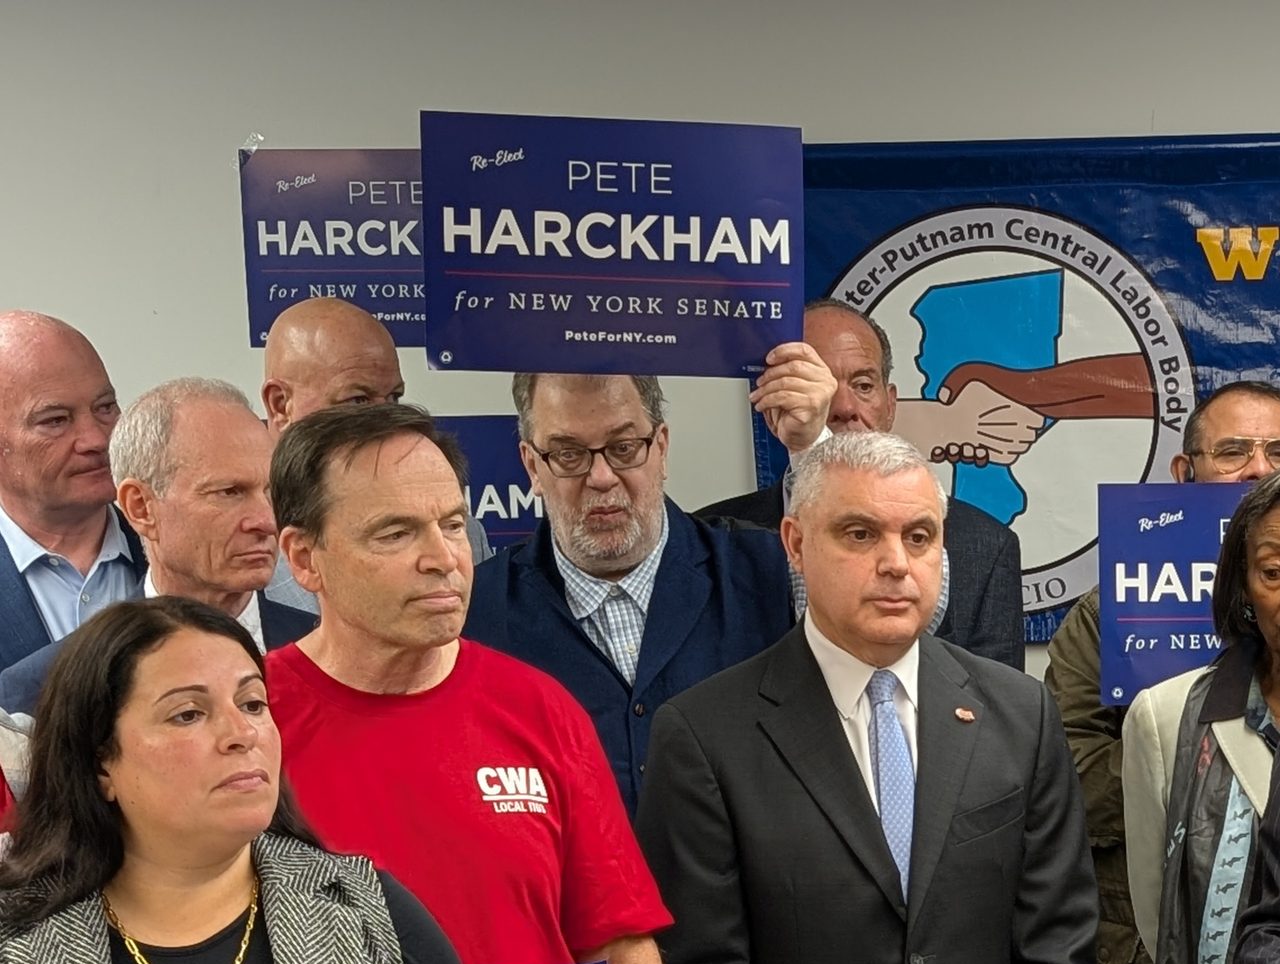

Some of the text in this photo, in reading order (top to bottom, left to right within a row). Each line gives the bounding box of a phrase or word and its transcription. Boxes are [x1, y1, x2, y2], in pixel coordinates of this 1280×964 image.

[471, 148, 524, 171] Re-Elect
[277, 173, 316, 192] Re-Elect
[569, 161, 672, 194] PETE
[349, 181, 422, 204] PETE
[256, 219, 421, 257] HARCK
[444, 207, 790, 264] HARCKHAM
[270, 284, 424, 300] for NEW YORK
[455, 291, 782, 318] for NEW YORK SENATE
[844, 216, 1183, 433] ter-Putnam Central Labor Body
[566, 331, 676, 343] PeteForNY.com
[1139, 511, 1183, 532] Re-Elect
[1125, 634, 1221, 652] for NEW
[477, 766, 548, 798] CWA
[493, 801, 527, 813] LOCAL
